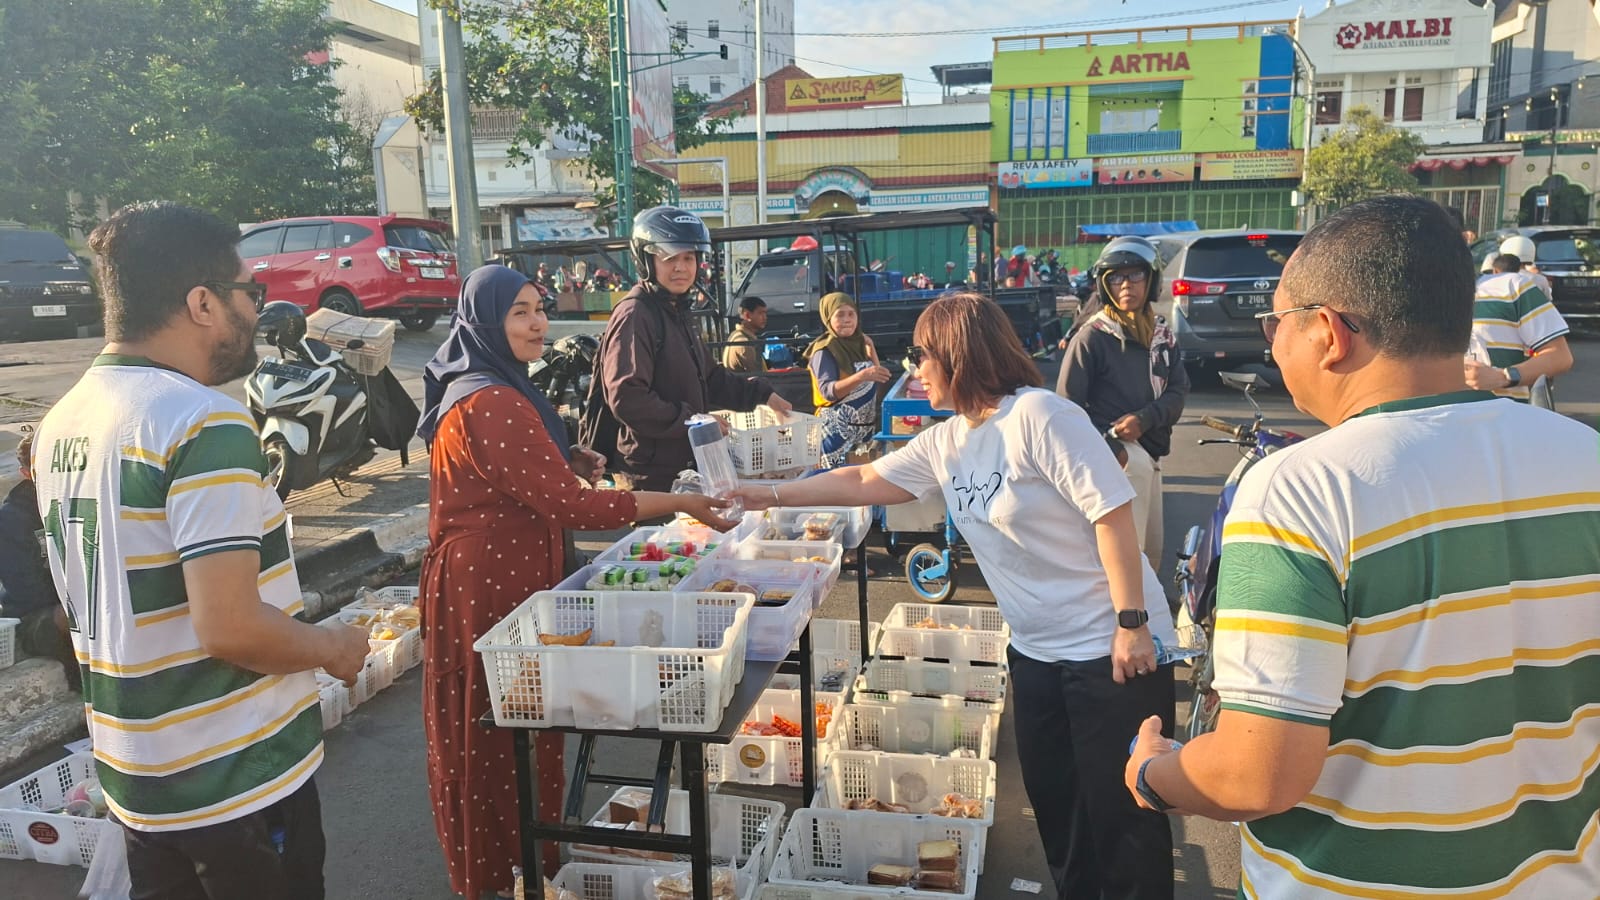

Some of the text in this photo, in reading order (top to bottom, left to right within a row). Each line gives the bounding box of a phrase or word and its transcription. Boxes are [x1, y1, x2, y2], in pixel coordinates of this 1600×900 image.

[1364, 17, 1453, 40] MALBI
[1109, 51, 1191, 74] ARTHA
[808, 79, 876, 99] SAKURA
[1240, 151, 1289, 159] COLLECTION
[1012, 160, 1078, 170] REVA SAFETY
[680, 200, 724, 210] LENGKAPA
[766, 199, 790, 208] MROH
[50, 436, 90, 474] AKES
